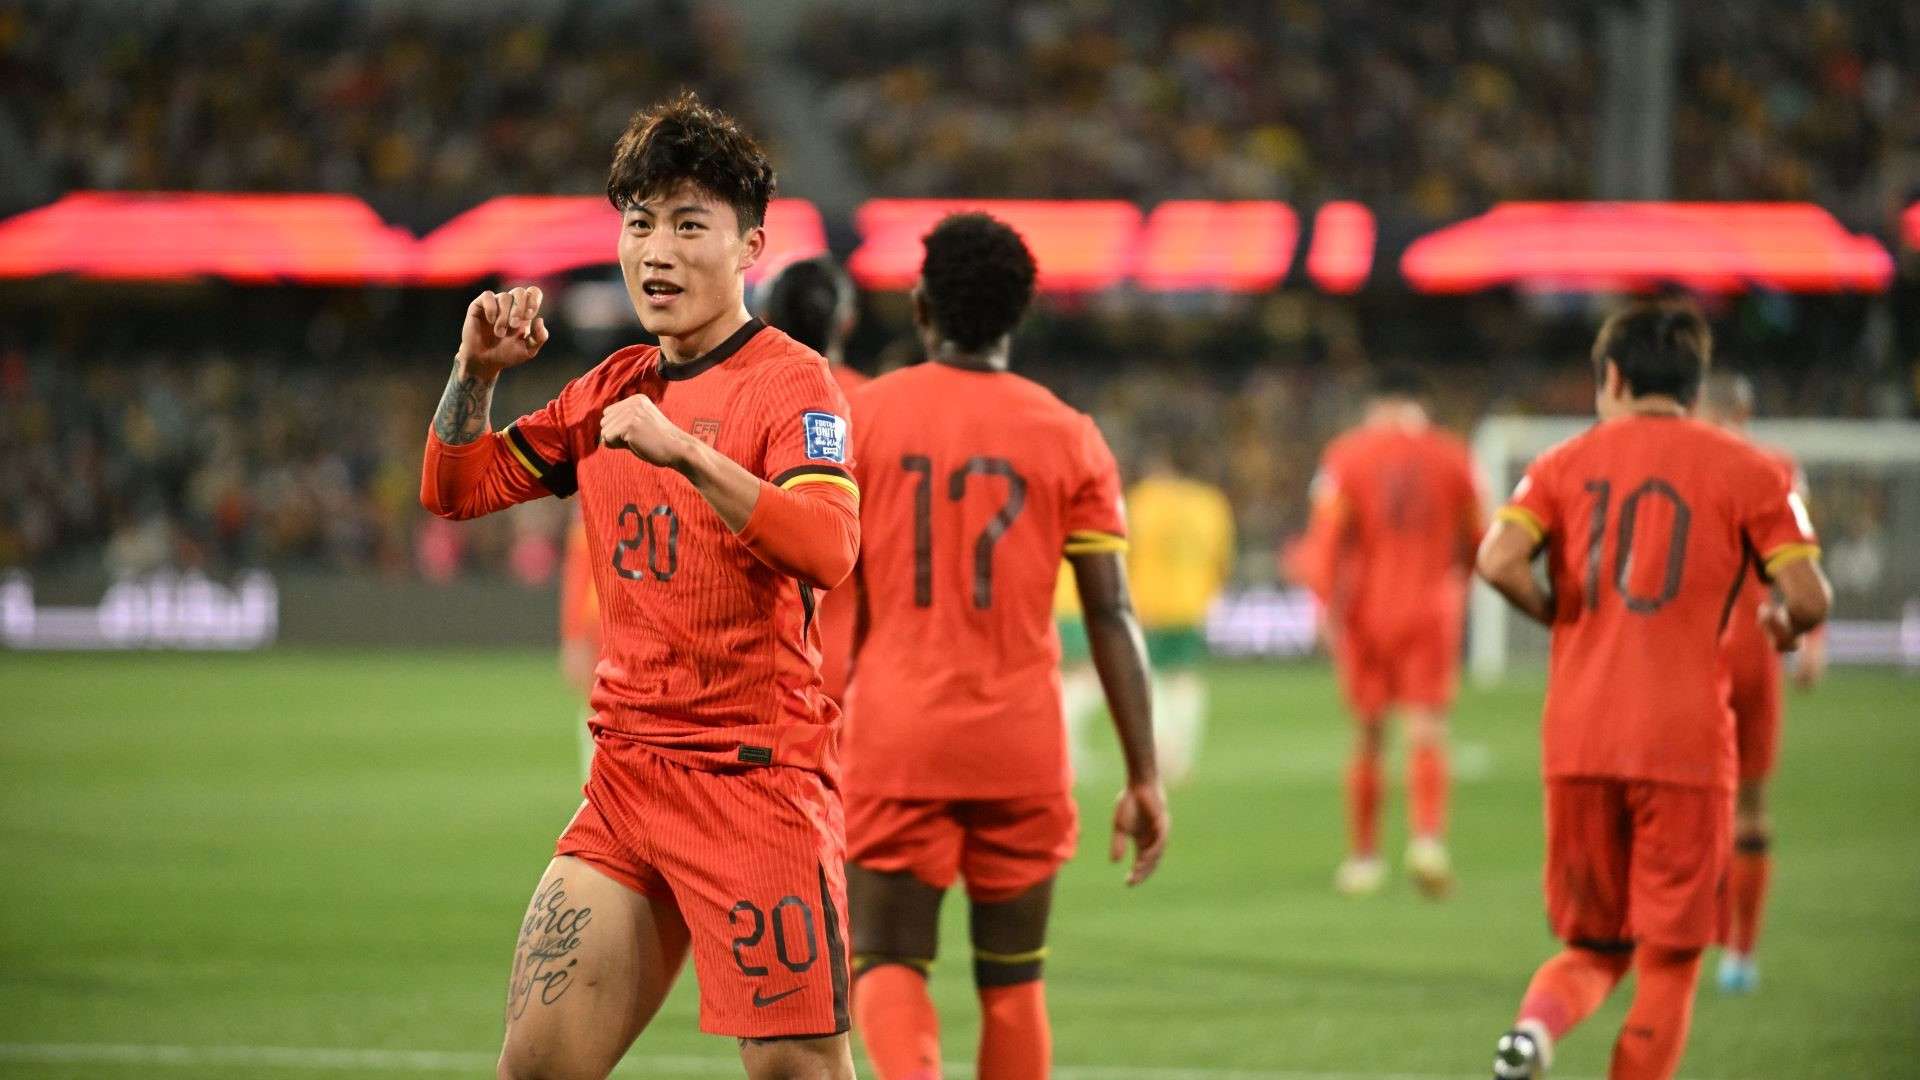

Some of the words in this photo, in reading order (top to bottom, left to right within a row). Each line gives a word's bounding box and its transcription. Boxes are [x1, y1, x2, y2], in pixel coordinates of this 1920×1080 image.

[612, 503, 679, 582] 20
[901, 455, 1027, 609] 17
[1584, 476, 1692, 615] 10
[728, 896, 817, 976] 20
